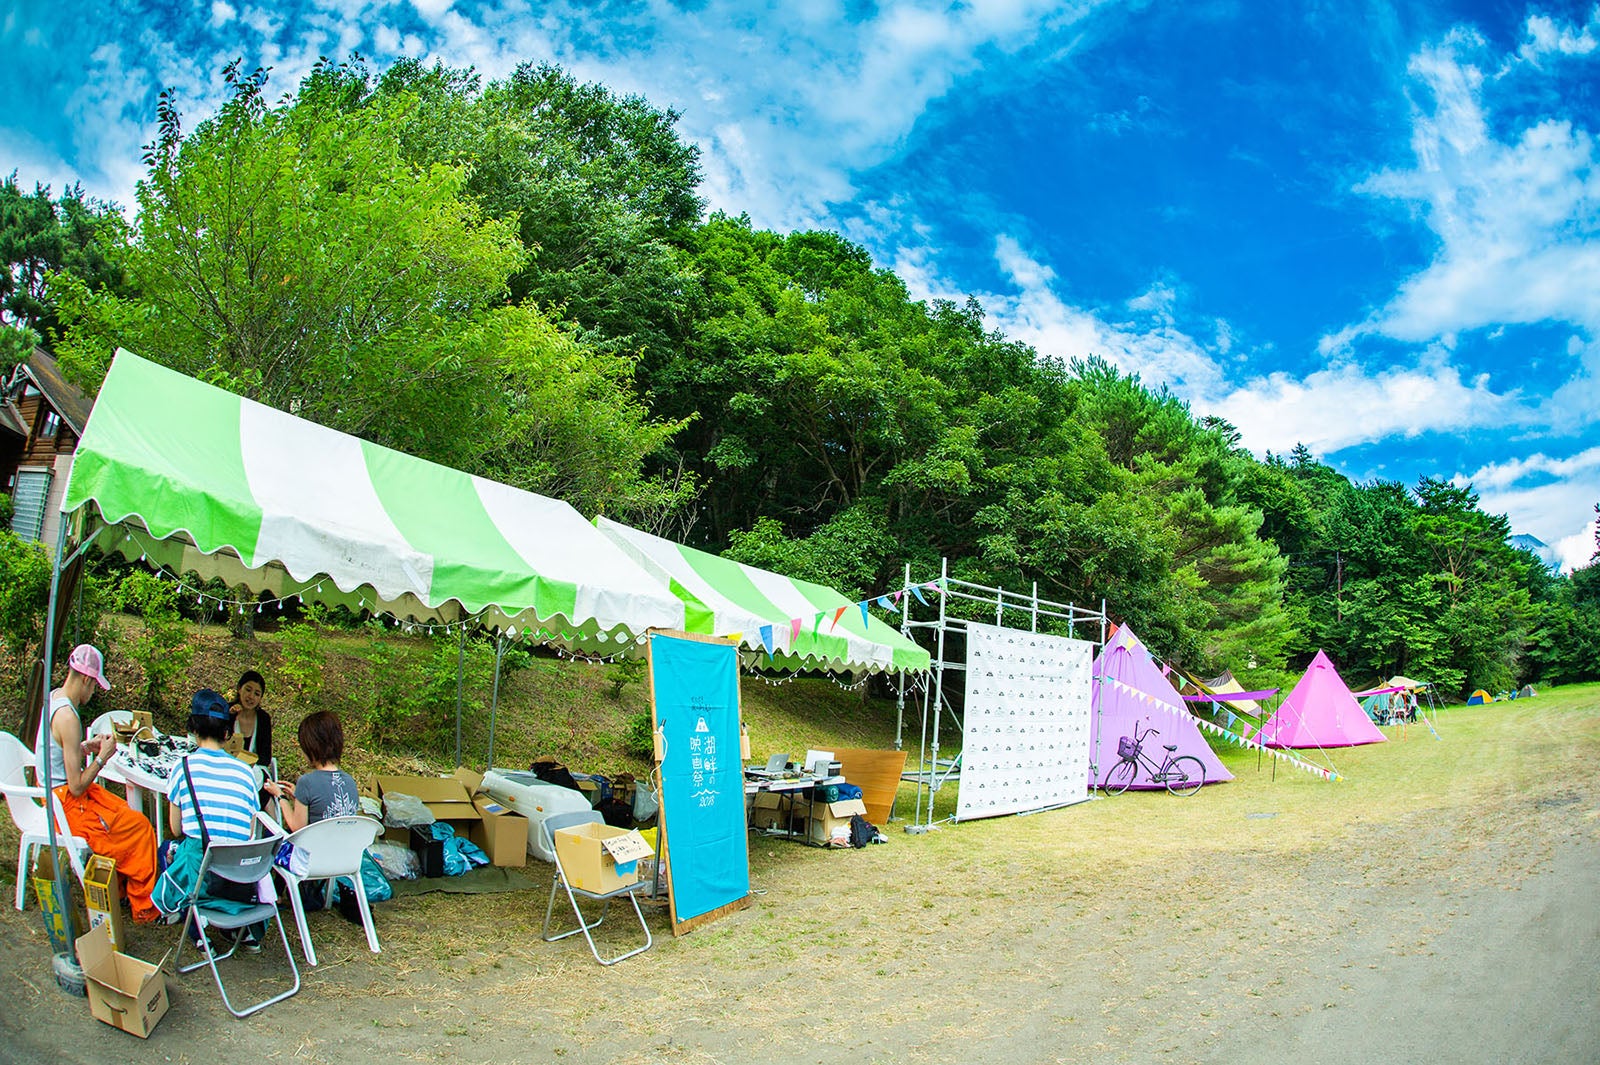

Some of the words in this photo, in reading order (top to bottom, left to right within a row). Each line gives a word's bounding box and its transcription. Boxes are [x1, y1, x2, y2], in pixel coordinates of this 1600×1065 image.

[690, 736, 704, 787] 映画祭
[704, 736, 718, 785] 湖畔の
